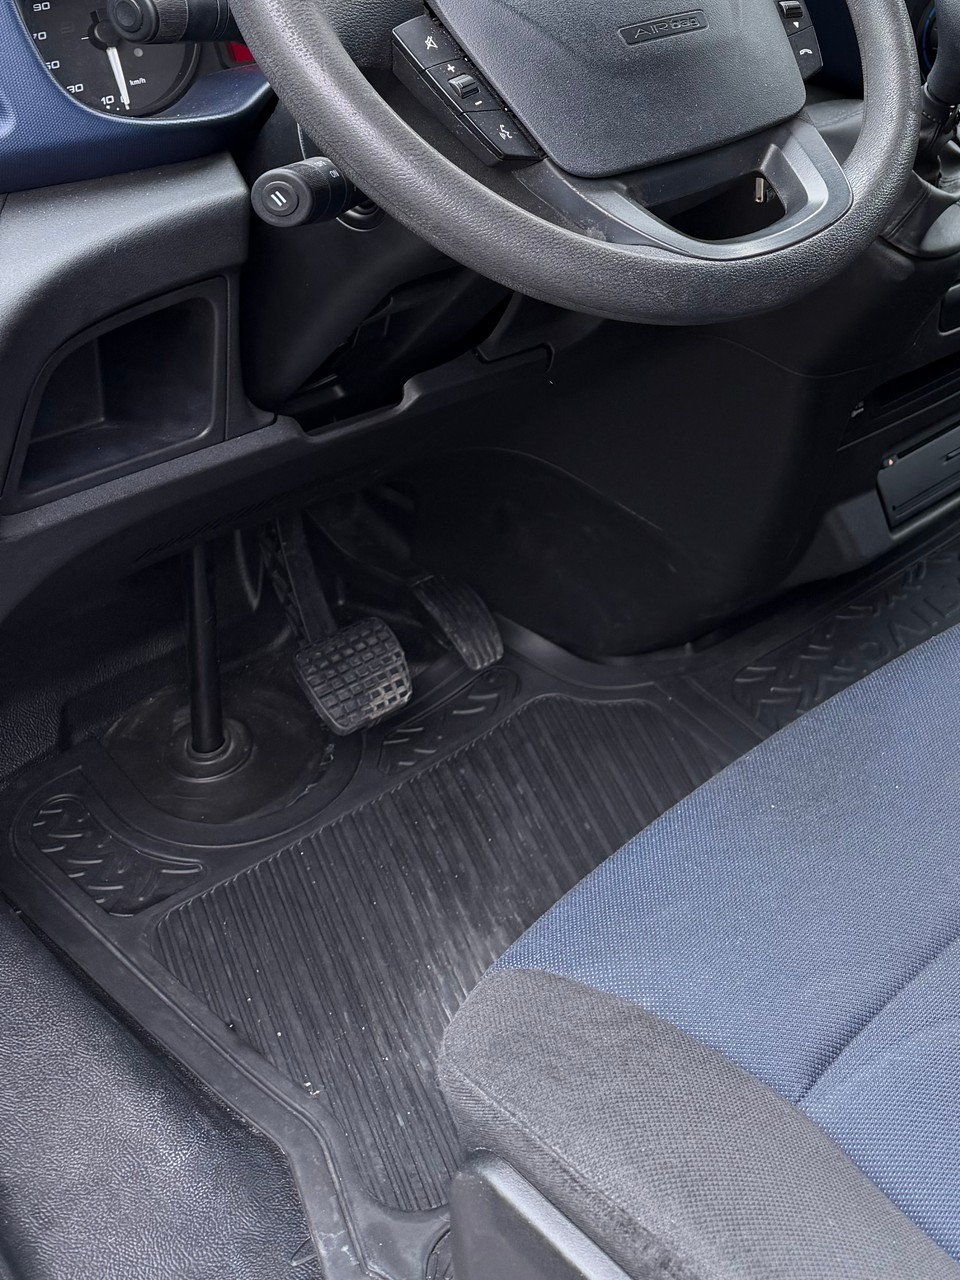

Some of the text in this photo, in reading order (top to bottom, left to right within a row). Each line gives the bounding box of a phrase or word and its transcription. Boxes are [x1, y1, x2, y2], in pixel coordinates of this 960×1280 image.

[32, 1, 50, 12] 90
[129, 77, 146, 86] km/h
[100, 95, 115, 105] 10
